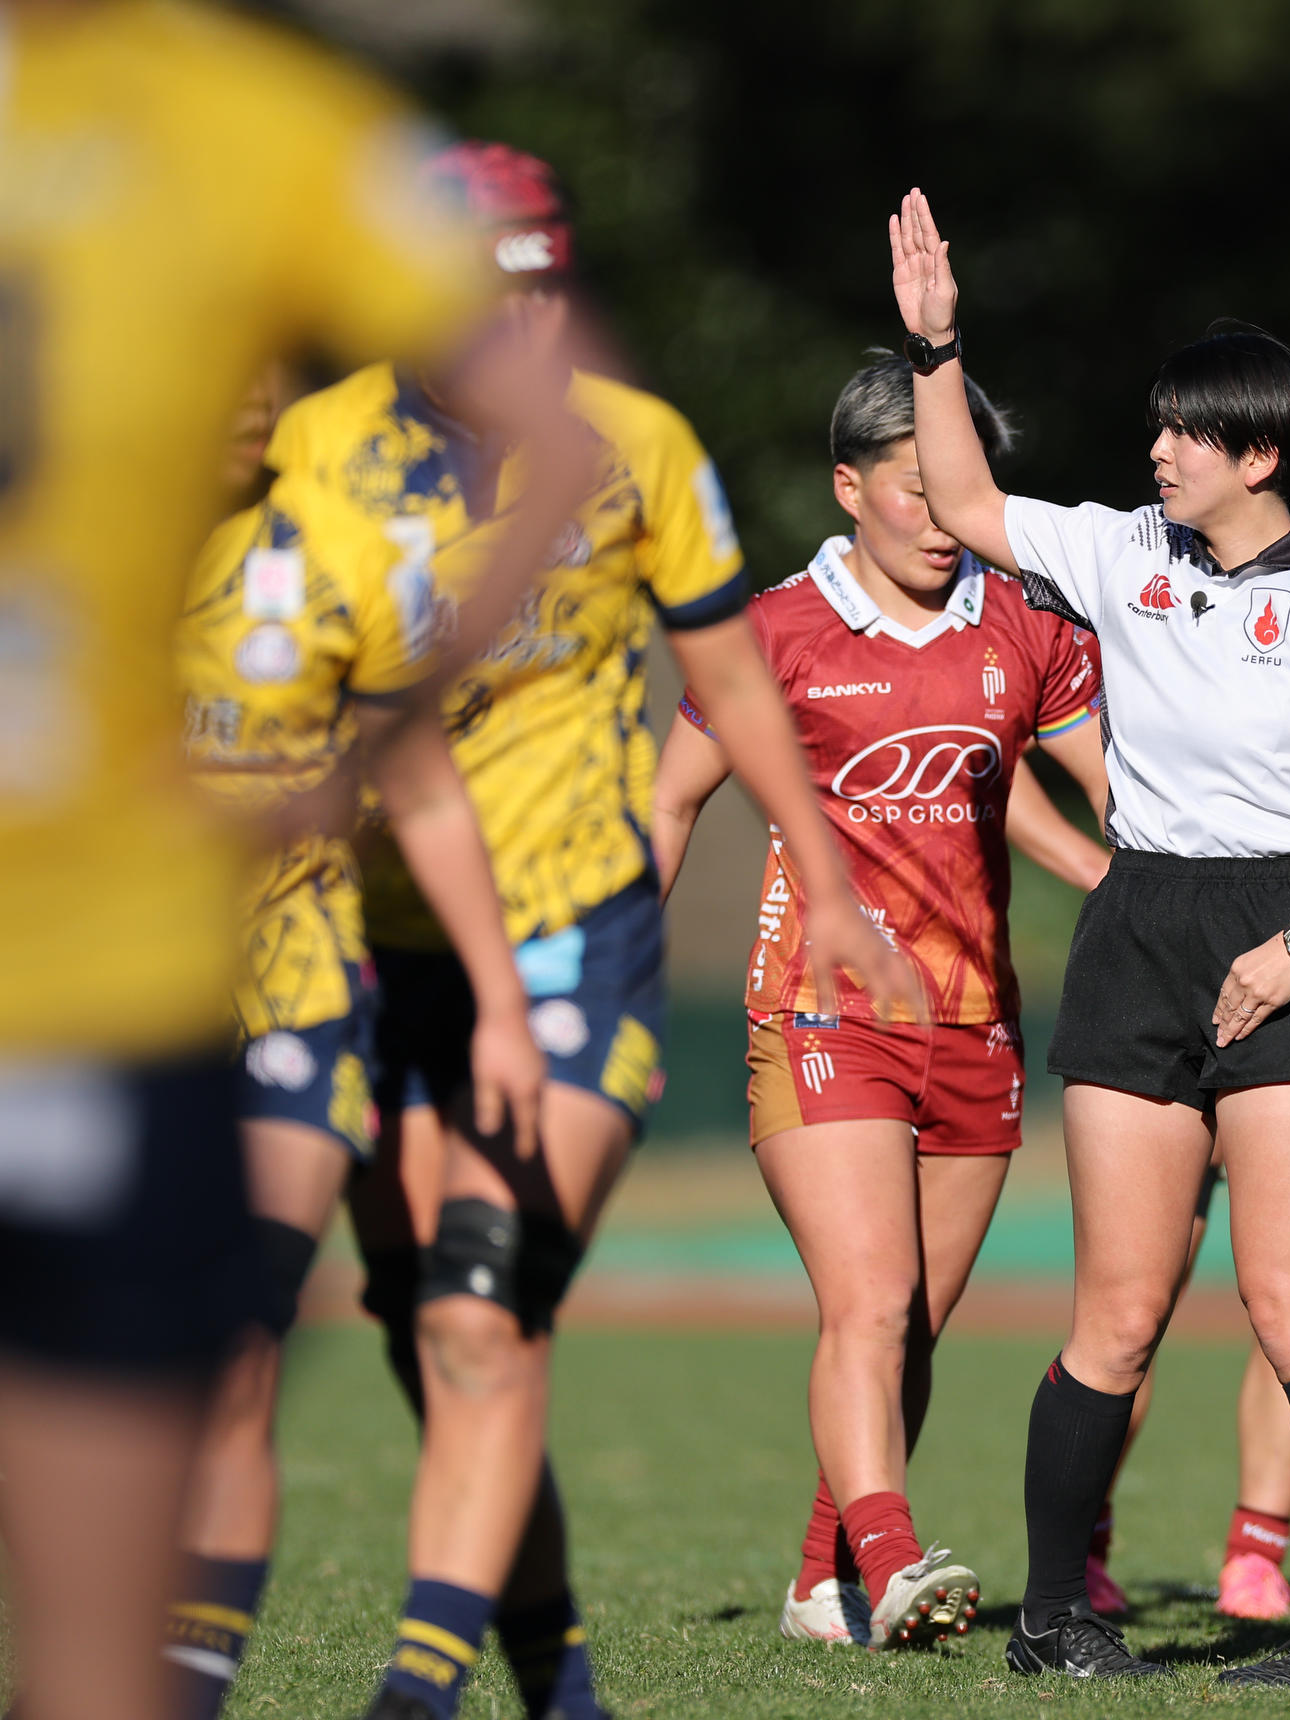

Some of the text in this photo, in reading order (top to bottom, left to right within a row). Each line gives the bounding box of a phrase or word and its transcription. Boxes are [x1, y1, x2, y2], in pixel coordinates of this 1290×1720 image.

[1127, 602, 1169, 625] canterbury
[1241, 655, 1282, 667] JERFU
[807, 682, 892, 699] SANKYU
[848, 803, 996, 824] OSP GROUP
